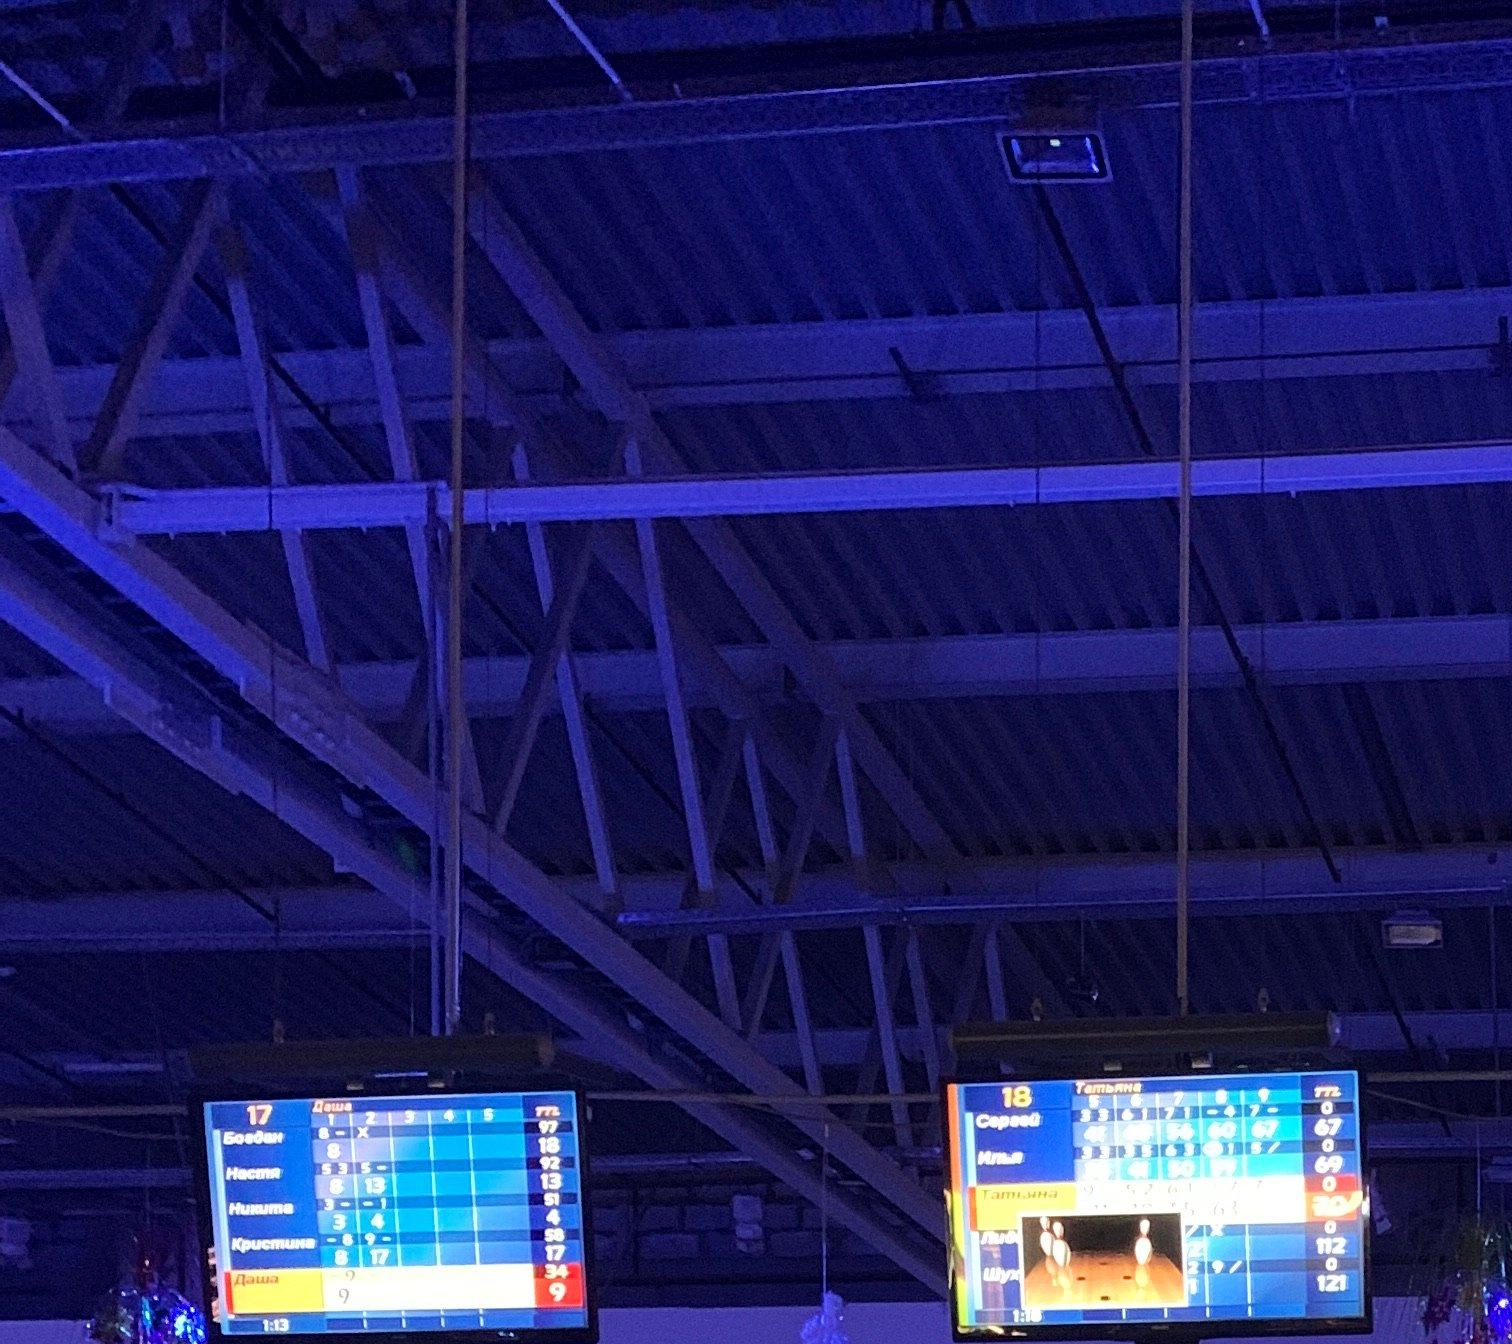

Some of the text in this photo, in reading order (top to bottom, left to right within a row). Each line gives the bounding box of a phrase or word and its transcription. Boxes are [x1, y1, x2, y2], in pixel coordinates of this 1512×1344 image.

[1002, 1087, 1032, 1108] 18
[246, 1105, 273, 1125] 17
[312, 1100, 352, 1114] Даша
[539, 1121, 557, 1133] 97
[1315, 1120, 1341, 1137] 67
[540, 1137, 560, 1154] 18
[540, 1158, 559, 1169] 92
[1315, 1157, 1343, 1173] 69
[541, 1173, 562, 1190] 13
[544, 1194, 559, 1205] 51
[546, 1246, 565, 1261] 17
[1317, 1238, 1345, 1254] 112
[234, 1273, 280, 1286] Даша
[545, 1265, 567, 1279] 34
[1318, 1275, 1346, 1291] 121
[549, 1284, 565, 1301] 9
[262, 1319, 289, 1332] 1:13
